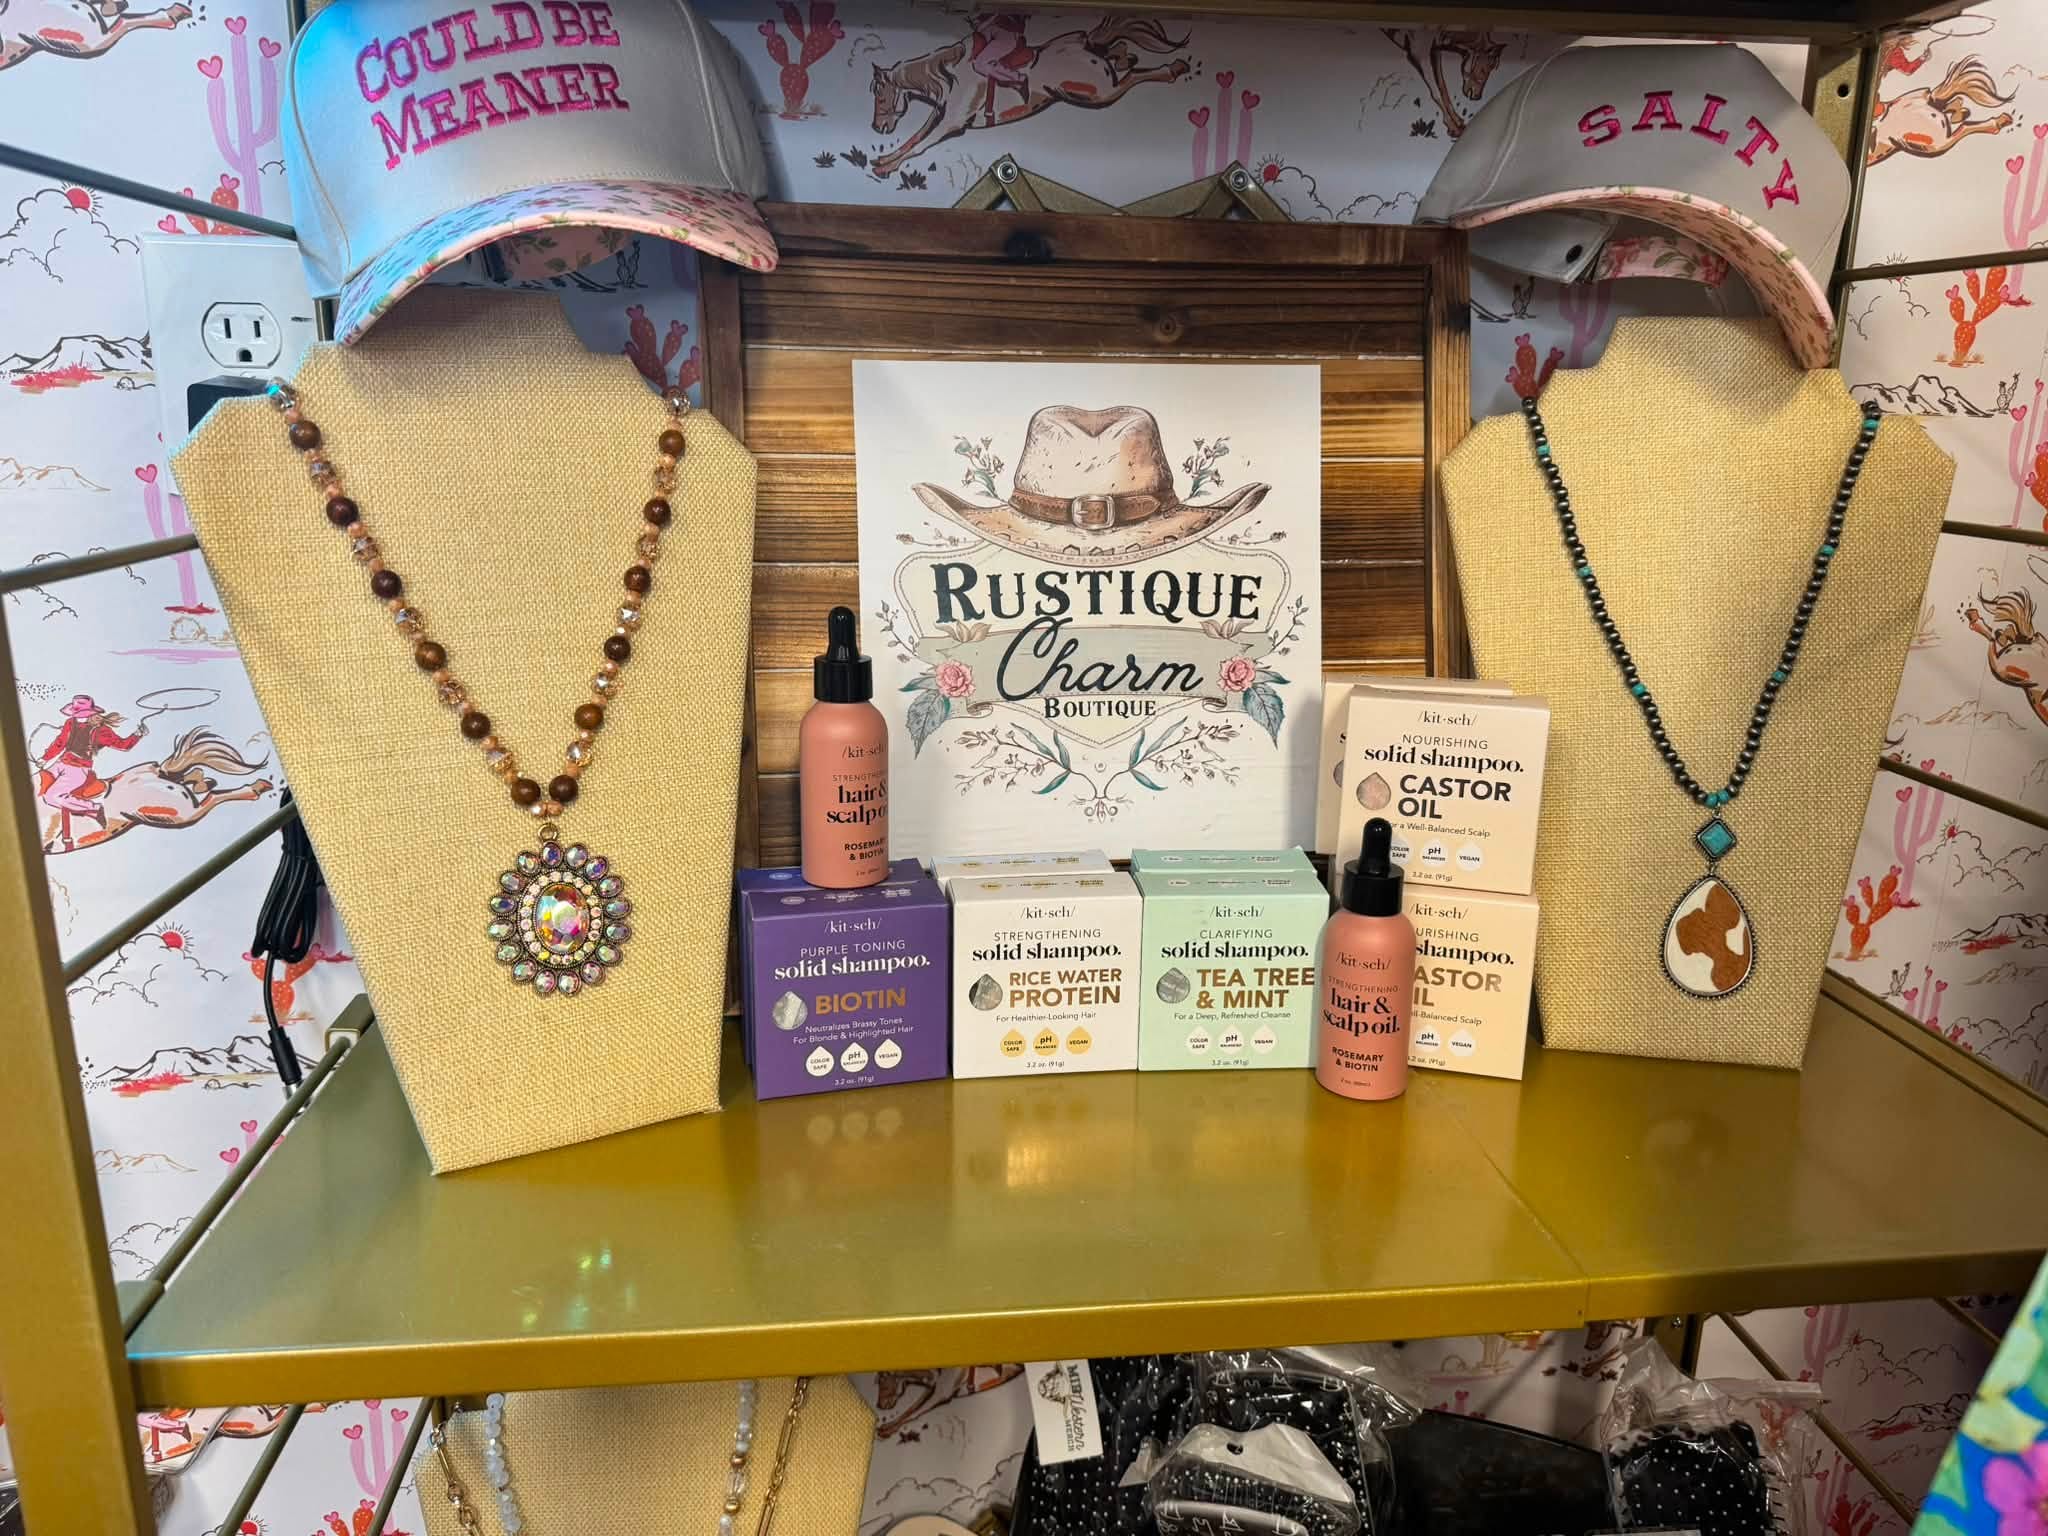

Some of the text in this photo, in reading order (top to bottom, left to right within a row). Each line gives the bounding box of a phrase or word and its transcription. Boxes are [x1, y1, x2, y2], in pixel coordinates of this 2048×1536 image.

[356, 0, 621, 103] COULD BE
[371, 62, 630, 170] MEANER
[1578, 90, 1800, 210] SALTY
[930, 562, 1262, 624] RUSTIQUE
[996, 616, 1204, 702] Charm
[1044, 699, 1157, 719] BOUTIQUE
[1402, 734, 1489, 750] NOURISHING
[1364, 745, 1524, 773] solid shampoo.
[838, 784, 877, 804] hair
[1400, 774, 1511, 802] CASTOR
[826, 804, 876, 826] scalp
[1398, 797, 1443, 819] OIL
[1407, 822, 1466, 835] Well-Balanced
[1468, 828, 1490, 839] Scalp
[1428, 847, 1441, 856] pH
[994, 929, 1101, 942] STRENGTHENING
[1200, 928, 1273, 939] CLARIFYING
[1416, 927, 1480, 942] URISHING
[800, 940, 906, 958] PURPLE TONING
[972, 942, 1122, 961] solid shampoo.
[1161, 941, 1309, 960] solid shampoo.
[1415, 939, 1514, 965] shampoo.
[774, 954, 931, 980] solid shampoo.
[1009, 968, 1122, 986] RICE WATER
[1196, 967, 1315, 987] TEA TREE
[1414, 965, 1502, 992] ASTOR
[815, 987, 907, 1015] BIOTIN
[1009, 985, 1121, 1009] PROTEIN
[1196, 989, 1289, 1009] & MINT
[1331, 987, 1391, 1014] hair &
[1413, 987, 1435, 1007] IL
[805, 1017, 903, 1034] Neutralizes Brassy Tones
[996, 1011, 1096, 1023] For Healthier-Looking Hair
[1196, 1012, 1219, 1021] Deep,
[1221, 1011, 1259, 1020] Refreshed
[1260, 1011, 1291, 1019] Cleanse
[1323, 1009, 1400, 1037] scalp oil.
[1411, 1010, 1482, 1027] ll-Balanced Scalp
[793, 1025, 914, 1044] For Blonde & Highlighted Hair
[1040, 1036, 1052, 1044] pH
[1225, 1034, 1238, 1043] pH
[1421, 1032, 1434, 1041] pH
[848, 1051, 861, 1060] pH
[1332, 1046, 1384, 1062] ROSEMARY
[1345, 1060, 1378, 1071] BIOTIN
